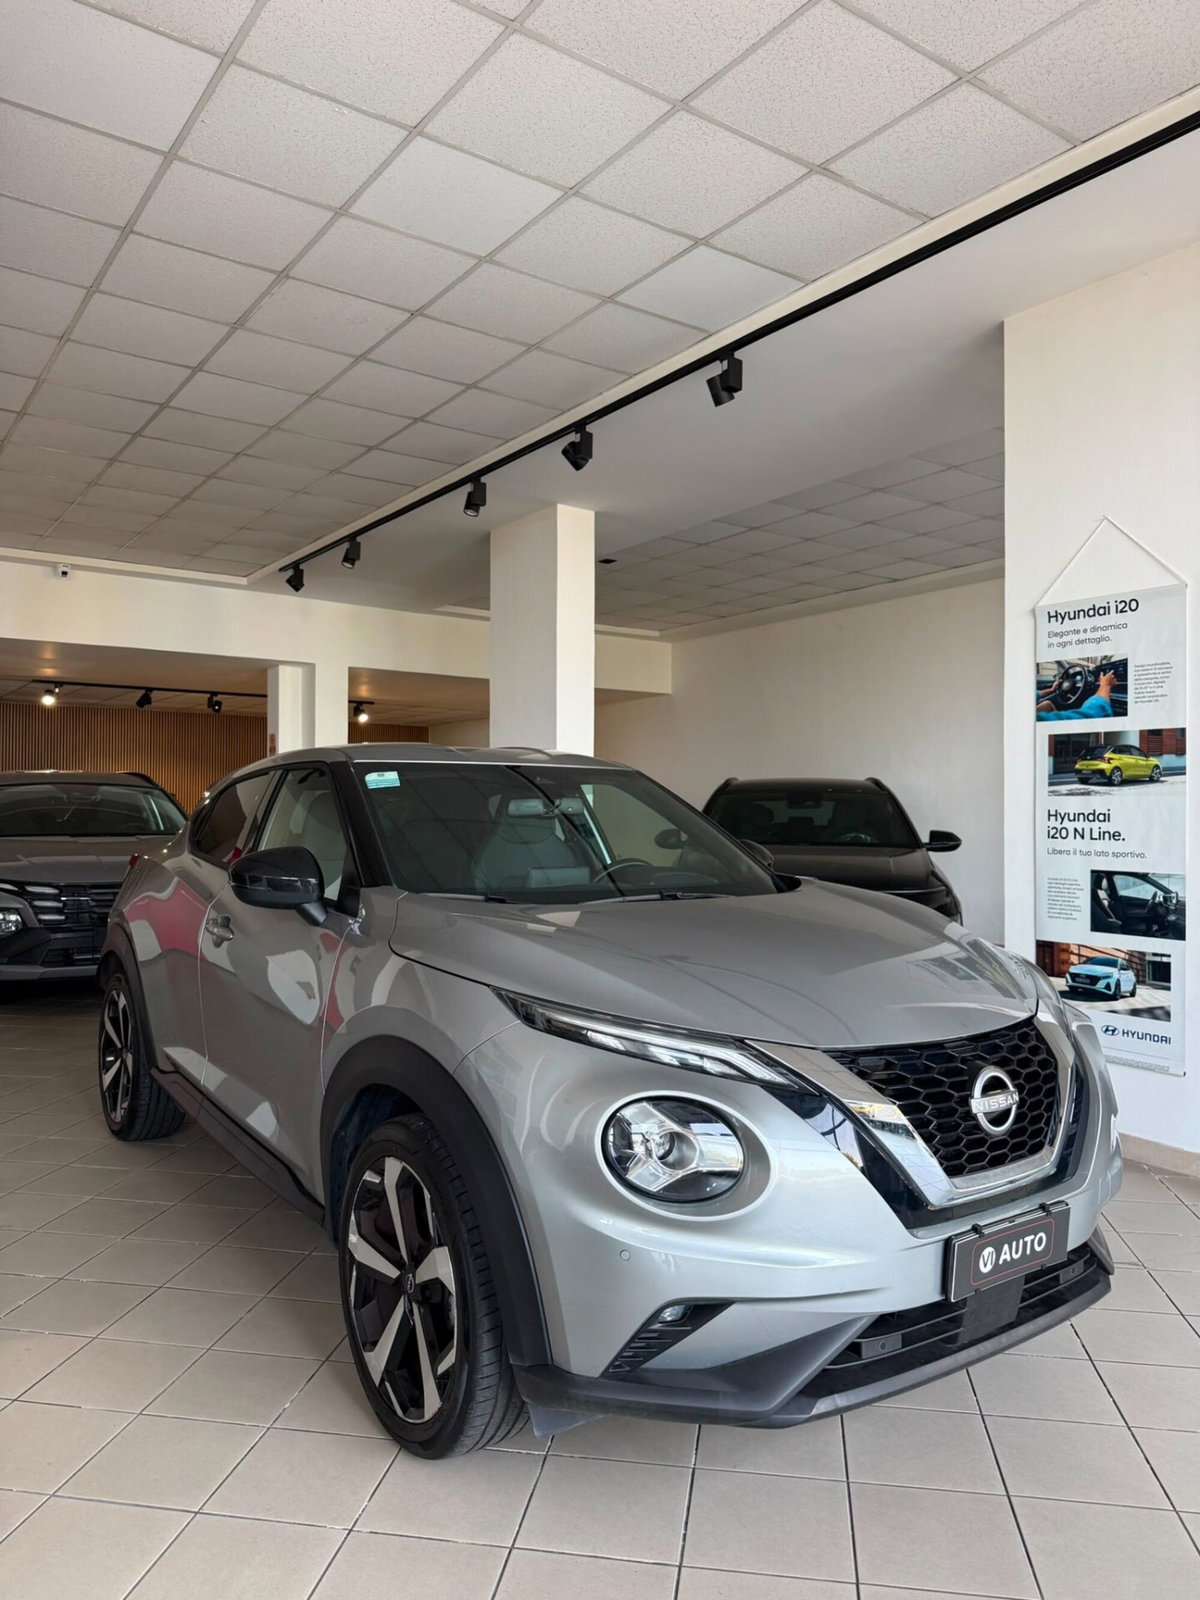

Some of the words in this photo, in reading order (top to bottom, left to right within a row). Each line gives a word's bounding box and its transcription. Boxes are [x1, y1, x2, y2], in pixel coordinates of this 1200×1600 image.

[1047, 601, 1111, 625] Hyundai
[1114, 598, 1140, 615] i20
[1047, 628, 1081, 639] Elegante
[1089, 622, 1128, 633] dinamica
[1047, 641, 1055, 649] in
[1056, 638, 1073, 649] ogni
[1074, 634, 1112, 646] dettaglio.
[1047, 809, 1111, 825] Hyundai
[1047, 826, 1069, 840] i20
[1073, 827, 1085, 840] N
[1089, 827, 1126, 841] Line.
[1047, 847, 1071, 856] Libera
[1072, 848, 1078, 856] il
[1079, 849, 1092, 857] tuo
[1094, 849, 1110, 858] lato
[1112, 850, 1147, 859] sportivo.
[1122, 1029, 1171, 1045] HYUNDAI
[972, 1091, 1019, 1111] NISSAN
[998, 1232, 1047, 1264] AUTO
